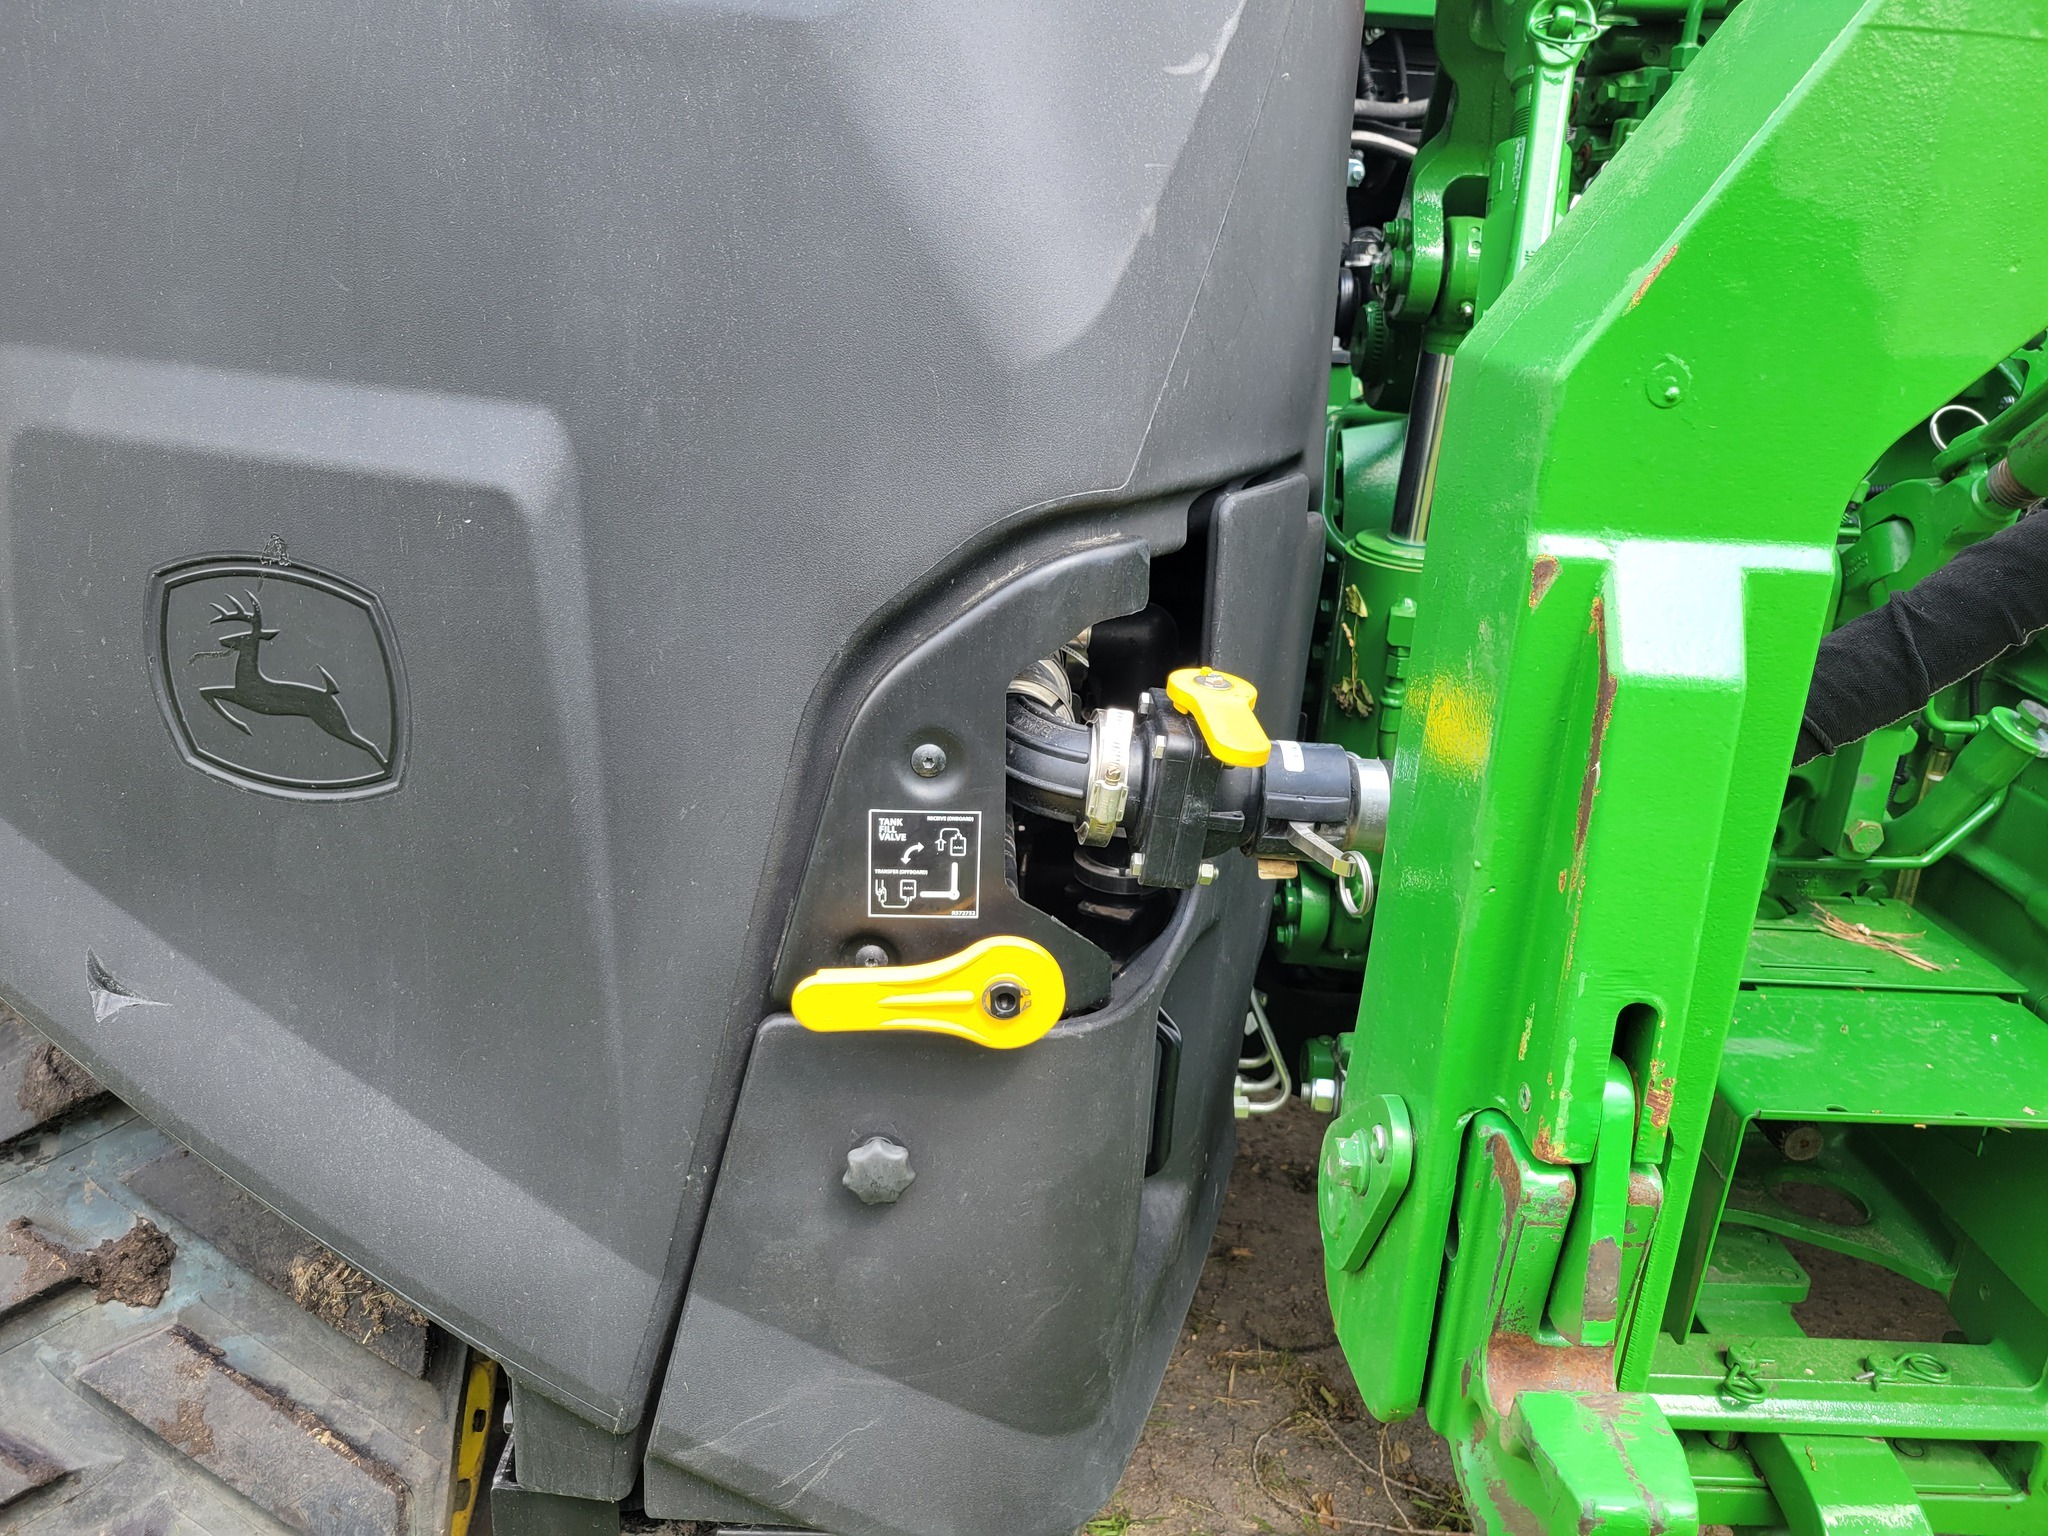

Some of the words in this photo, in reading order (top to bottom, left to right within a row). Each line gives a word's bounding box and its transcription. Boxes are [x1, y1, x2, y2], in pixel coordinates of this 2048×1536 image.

[879, 818, 904, 826] TANK
[879, 825, 898, 833] FILL
[878, 832, 907, 842] VALVE
